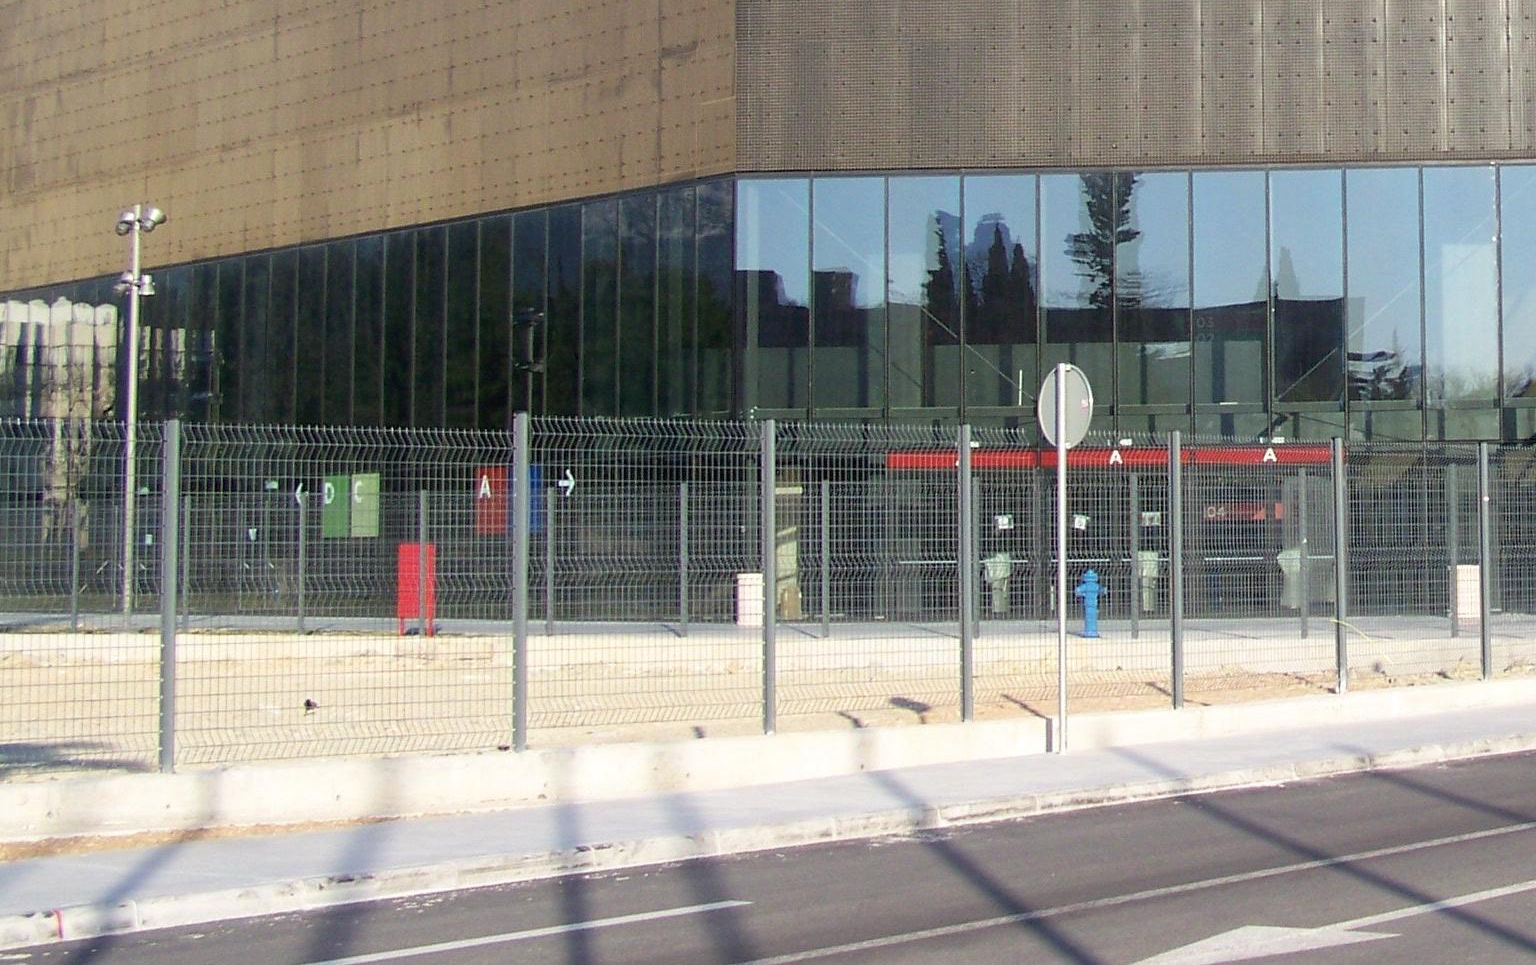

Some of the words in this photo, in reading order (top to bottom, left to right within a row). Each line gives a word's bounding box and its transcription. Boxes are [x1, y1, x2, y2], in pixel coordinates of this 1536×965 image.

[1109, 449, 1123, 465] A
[1263, 447, 1277, 462] A
[324, 482, 335, 505] D
[354, 480, 363, 504] C
[479, 474, 492, 499] A
